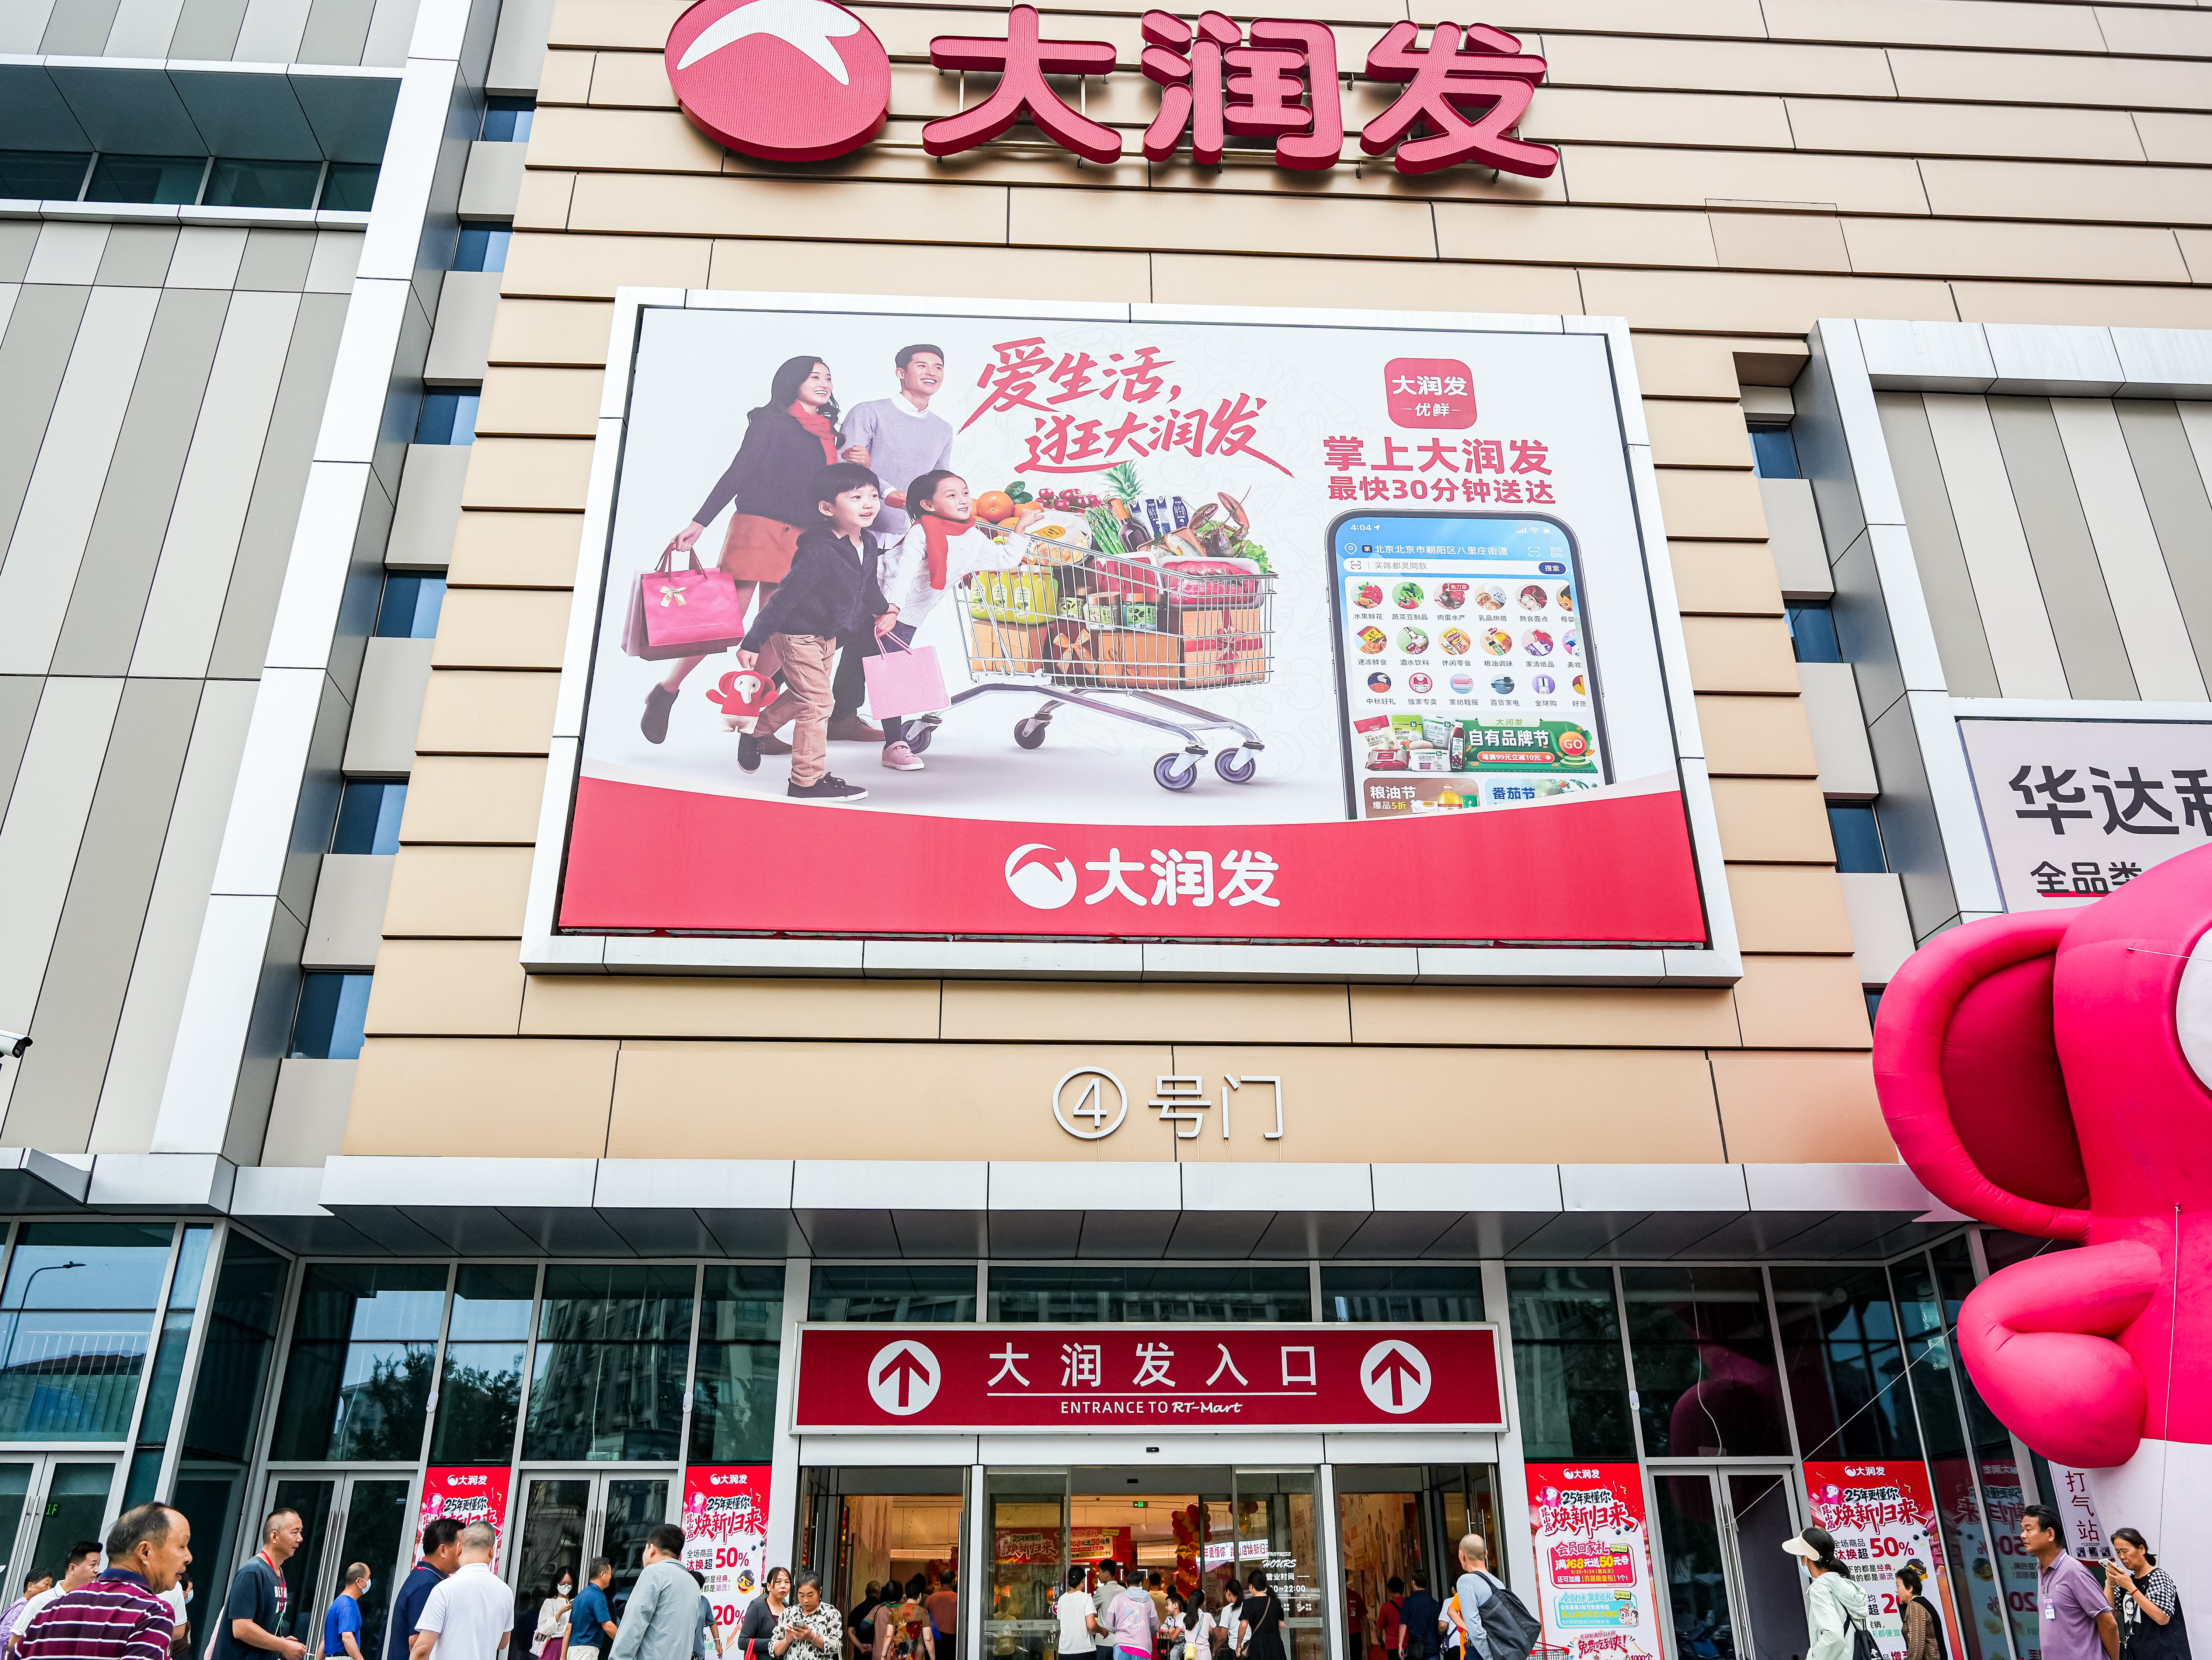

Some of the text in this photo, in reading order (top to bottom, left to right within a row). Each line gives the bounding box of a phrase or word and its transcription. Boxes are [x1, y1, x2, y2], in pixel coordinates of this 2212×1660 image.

[922, 3, 1559, 178] 大润发
[1392, 375, 1468, 396] 大润发
[1415, 402, 1450, 417] 优鲜
[1014, 393, 1295, 478] 逛大润发
[1324, 436, 1552, 475] 掌上大润发
[1329, 476, 1555, 503] 最快30分钟送达
[1374, 544, 1508, 555] 北京北京市朝阳区八里庄街道
[1469, 729, 1549, 747] 自有品牌节
[1564, 739, 1583, 749] GO
[1370, 785, 1416, 799] 粮油节
[1492, 787, 1535, 800] 番茄节
[1372, 801, 1406, 810] 爆品5折
[1084, 847, 1280, 907] 大润发
[987, 1342, 1317, 1387] 大润发入口
[1061, 1401, 1243, 1414] ENTRANCE TO RT-Mart
[1573, 1469, 1600, 1479] 大润发
[1856, 1466, 1886, 1476] 大润发
[458, 1475, 488, 1486] 大润发
[720, 1474, 747, 1485] 大润发
[1562, 1491, 1612, 1505] 25年更懂你
[1844, 1488, 1899, 1503] 25年更懂你
[46, 1503, 58, 1514] 1F
[444, 1498, 488, 1513] 25年更懂你
[707, 1497, 750, 1511] 25年更懂你
[2065, 1470, 2100, 1542] 打气站
[1541, 1508, 1552, 1532] 昆山店
[1552, 1502, 1635, 1537] 焕新归来
[1822, 1505, 1836, 1530] 昆山店
[1833, 1499, 1928, 1534] 焕新归来
[693, 1509, 767, 1543] 焕新归来
[1005, 1539, 1059, 1560] 焕新归来
[1556, 1540, 1609, 1555] 会员回家礼
[1834, 1539, 1866, 1548] 全场商品
[1870, 1537, 1915, 1558] 50%
[686, 1549, 713, 1558] 全场商品
[715, 1547, 749, 1568] 50%
[1835, 1549, 1869, 1560] 汰换超
[686, 1559, 713, 1571] 汰换超
[1262, 1559, 1297, 1568] HOURS
[1555, 1555, 1629, 1570] 满168元送50元券
[1266, 1573, 1295, 1581] 营业时间
[713, 1605, 745, 1626] 20%
[1868, 1604, 1880, 1615] 超
[1578, 1635, 1628, 1659] 免费吃到爽！
